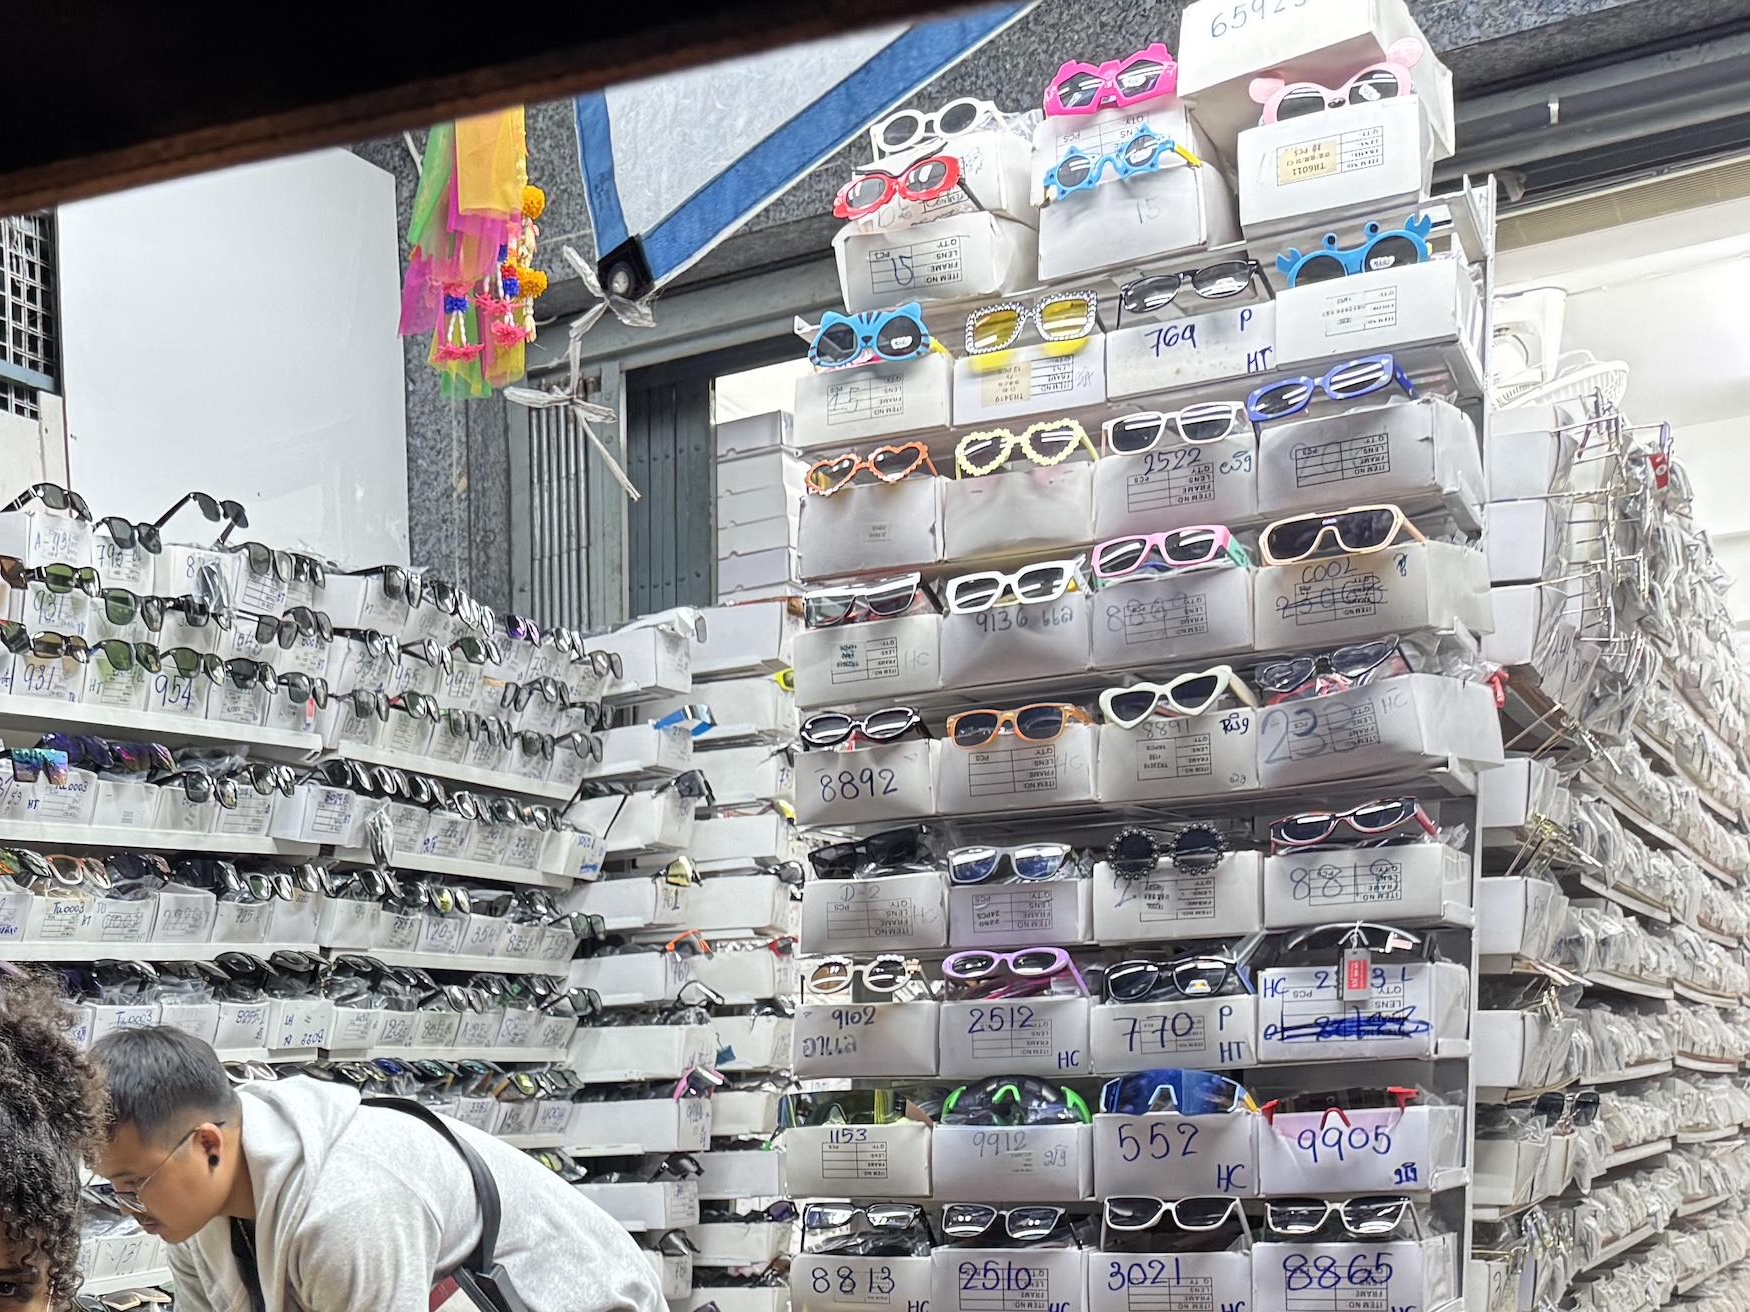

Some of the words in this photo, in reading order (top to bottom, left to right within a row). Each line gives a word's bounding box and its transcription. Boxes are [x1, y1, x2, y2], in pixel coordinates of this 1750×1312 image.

[819, 768, 898, 802] 8892
[967, 1005, 1035, 1034] 2512
[1113, 1011, 1196, 1052] 770
[1057, 1050, 1080, 1070] HC
[1219, 1041, 1246, 1064] HT
[1297, 1124, 1393, 1163] 9905
[1216, 1164, 1248, 1192] HC
[810, 1265, 896, 1295] 8813
[958, 1260, 1033, 1292] 2510
[1107, 1257, 1183, 1292] 3021
[1281, 1252, 1394, 1292] 8865
